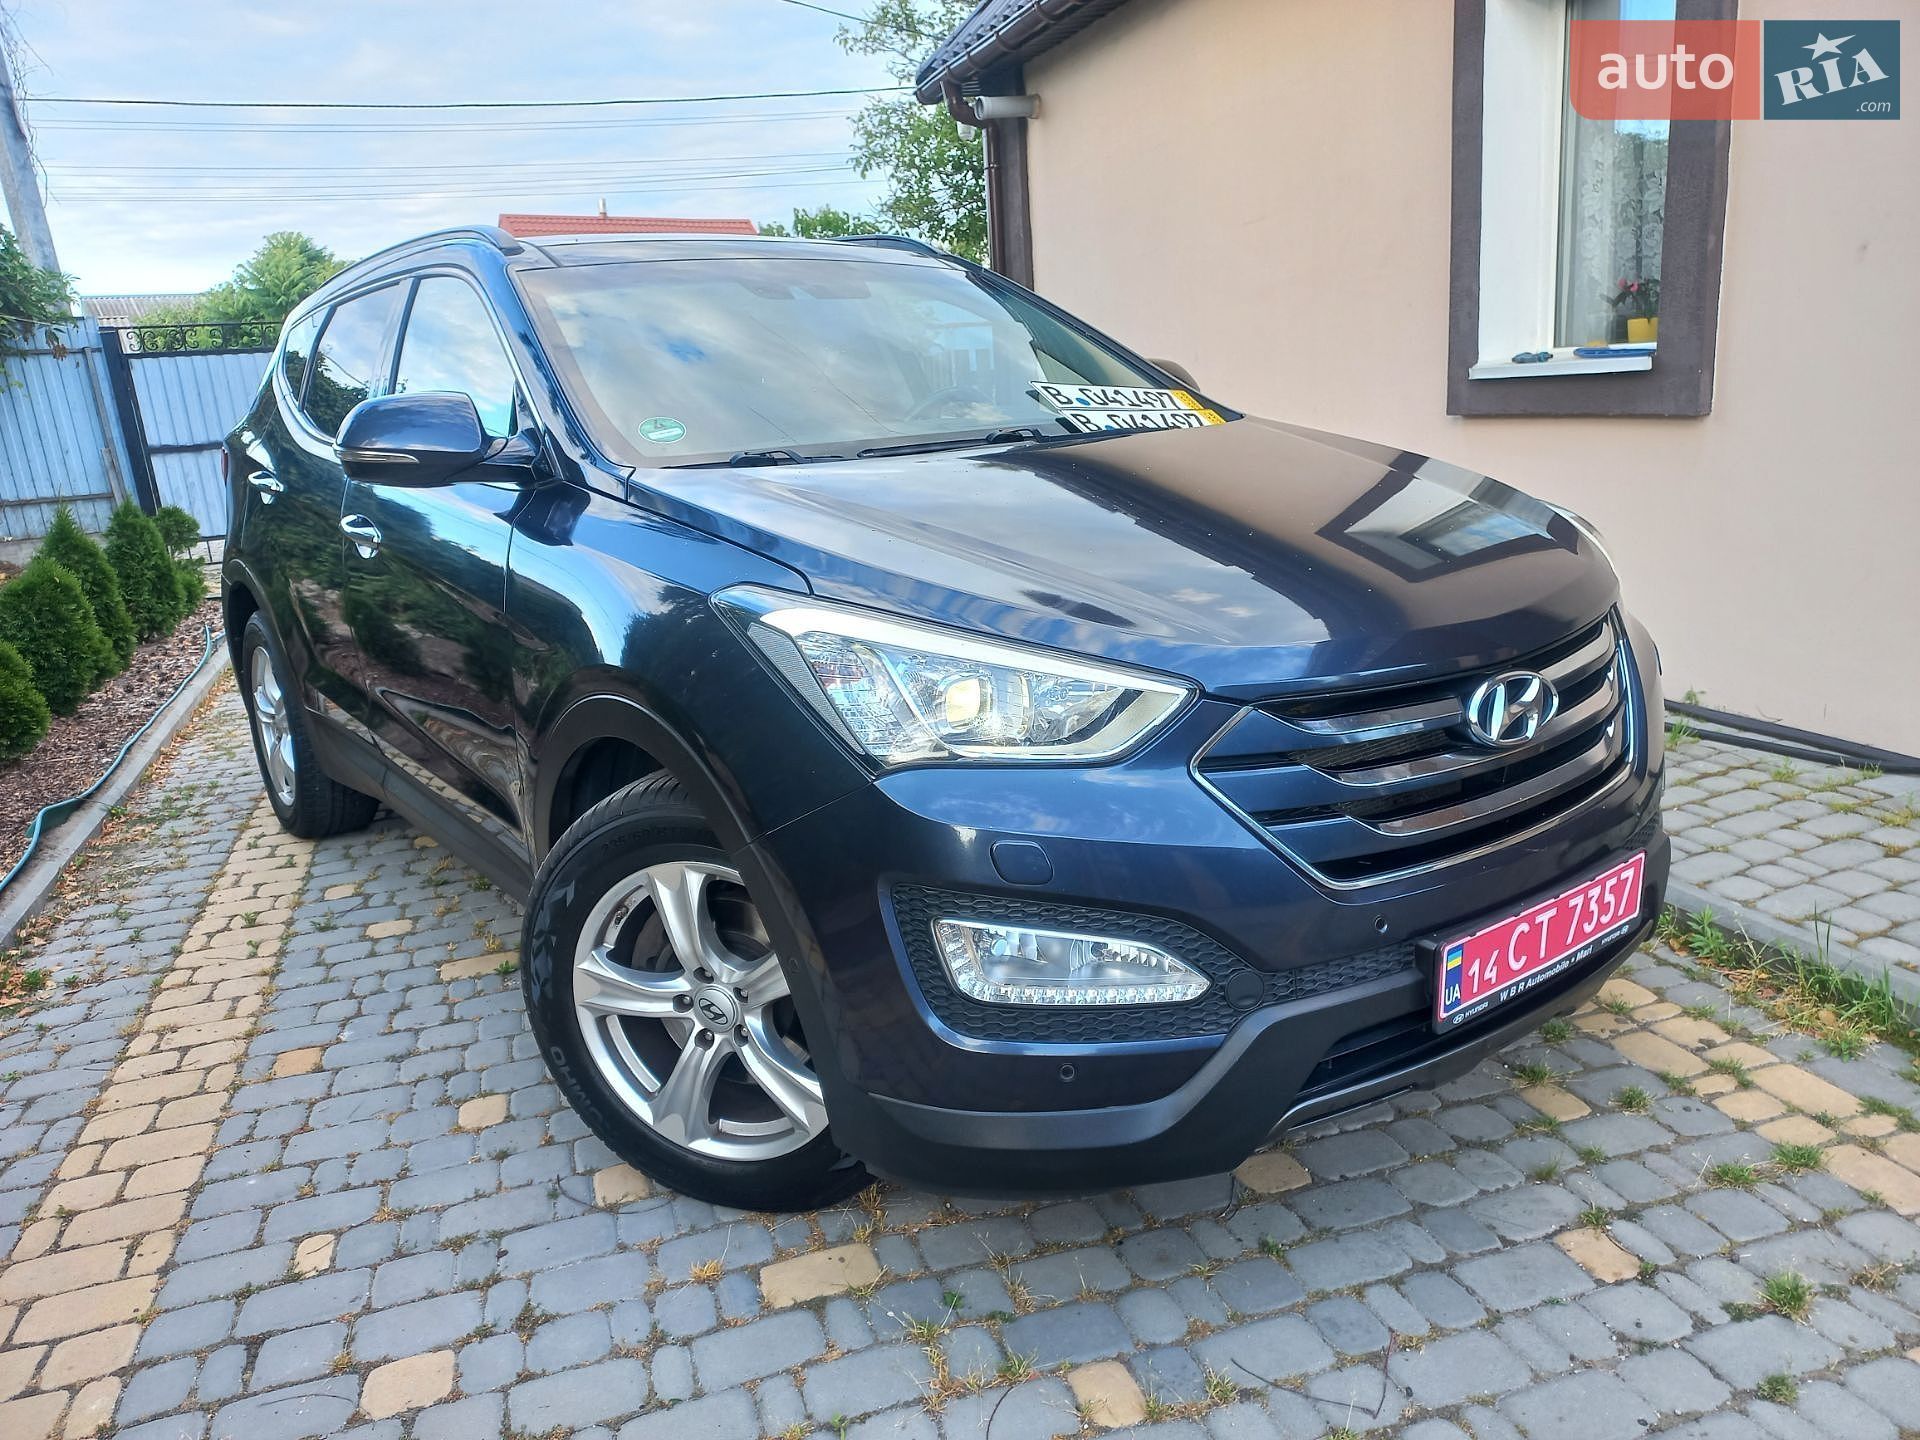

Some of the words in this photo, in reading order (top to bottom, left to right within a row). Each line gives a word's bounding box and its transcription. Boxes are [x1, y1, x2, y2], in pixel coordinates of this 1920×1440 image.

[1041, 386, 1073, 405] B
[1070, 413, 1103, 432] B
[1467, 949, 1500, 994] 14
[1507, 906, 1558, 972] CT
[1565, 866, 1635, 946] 7357
[1525, 959, 1570, 989] Automobile
[1445, 983, 1461, 1006] UA
